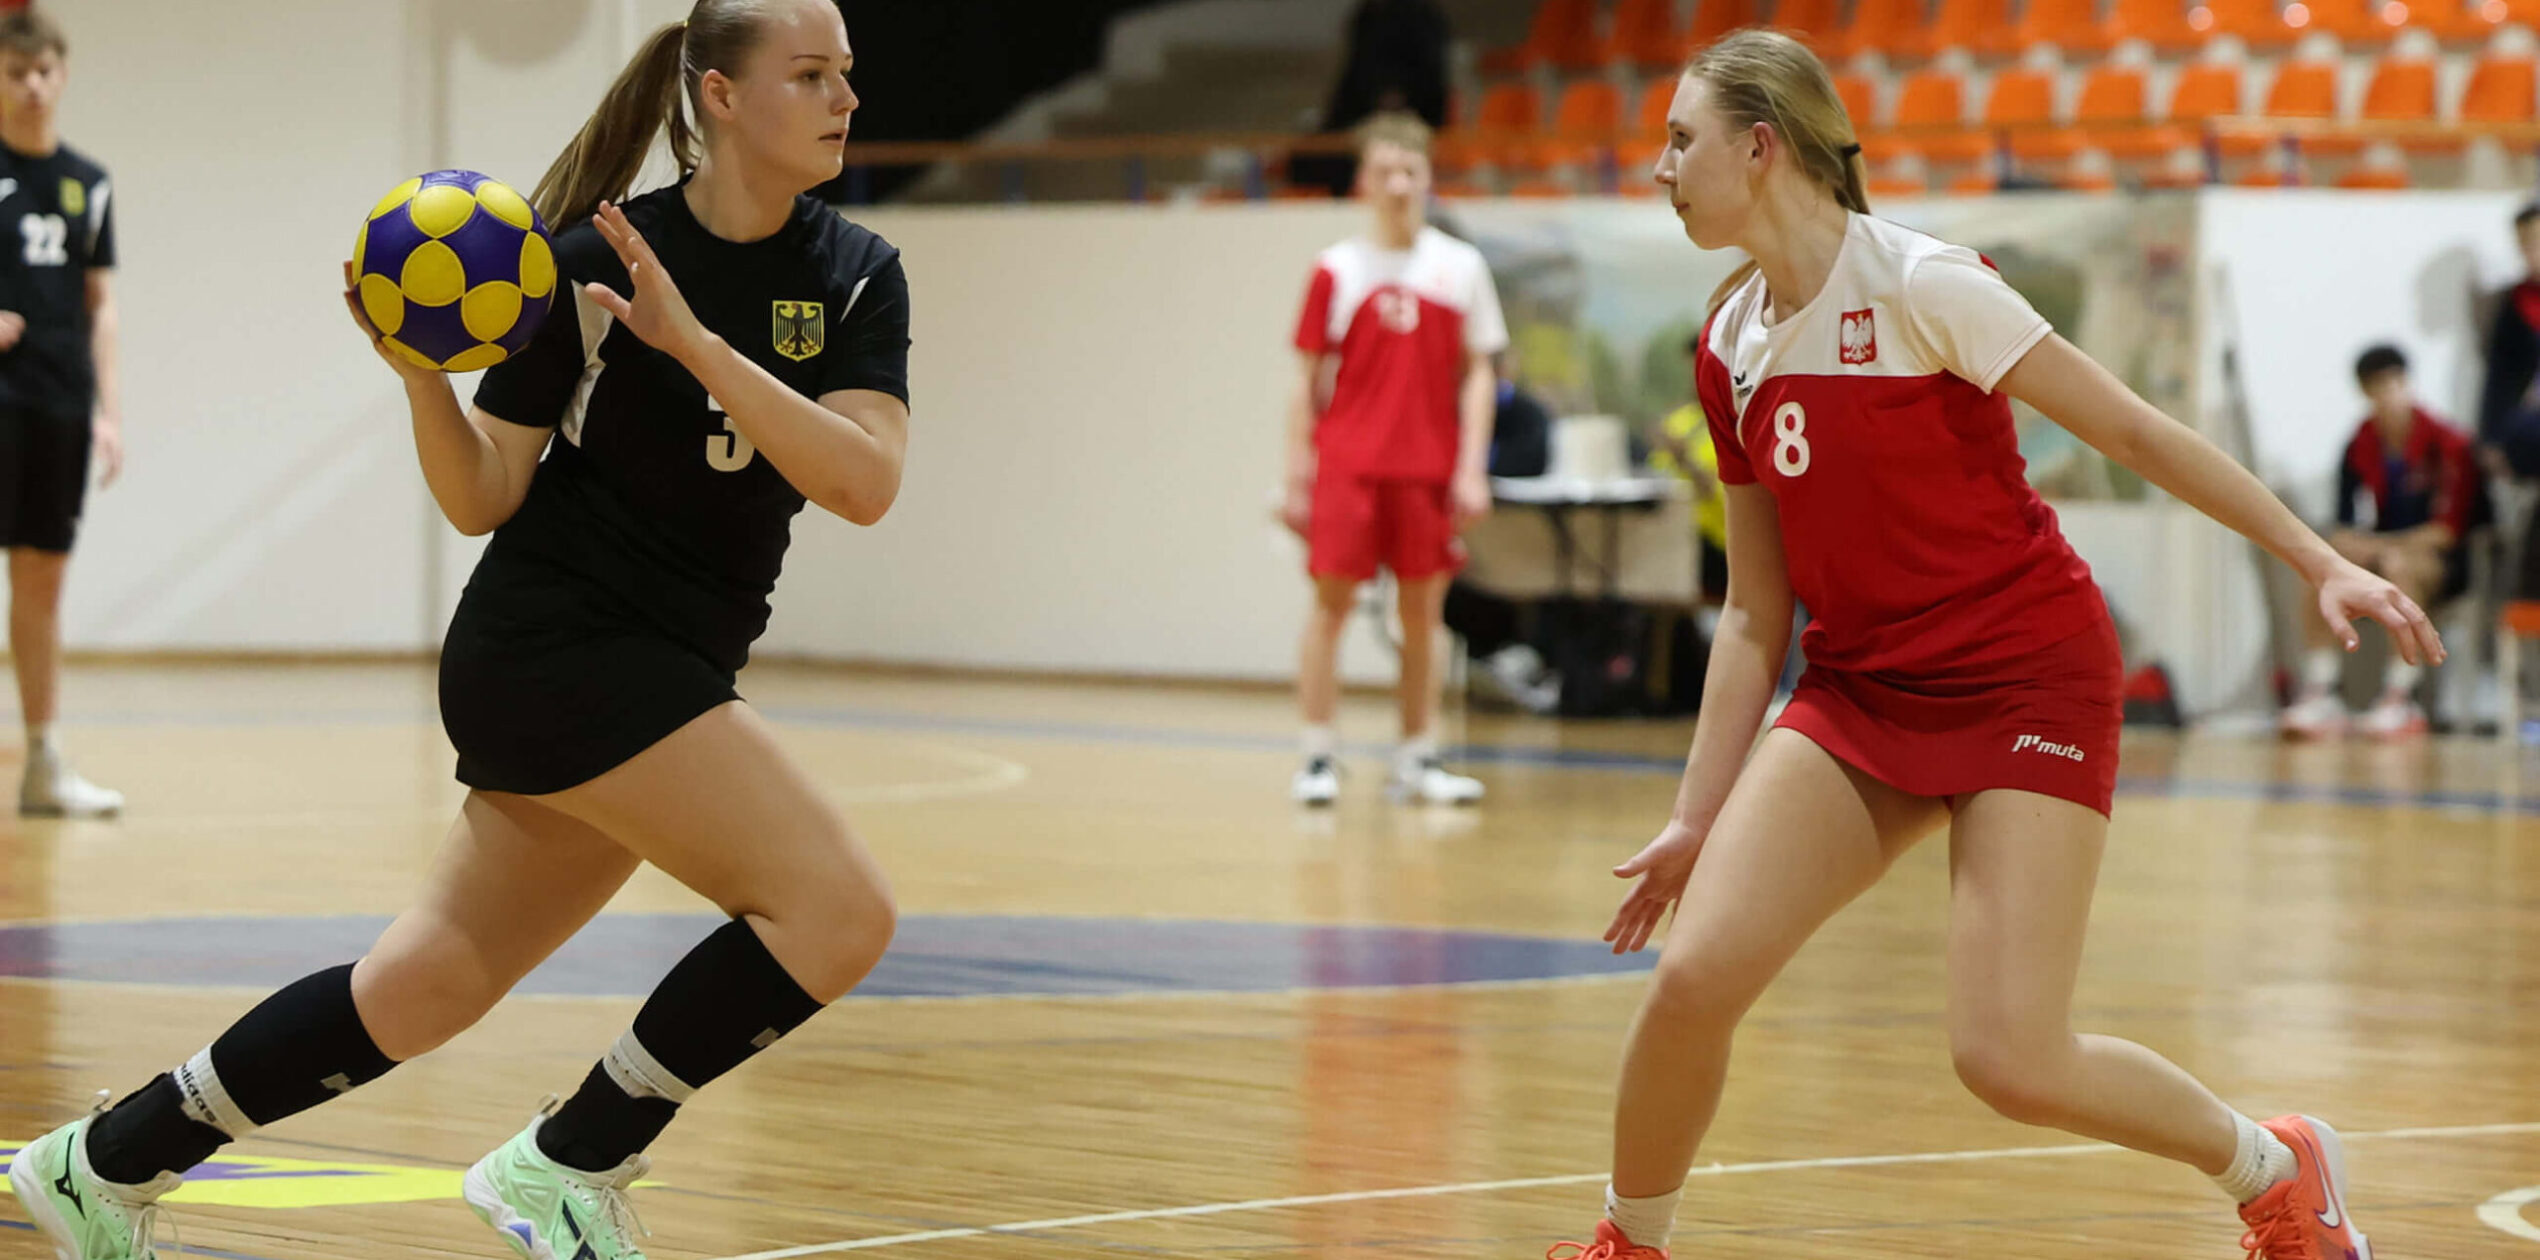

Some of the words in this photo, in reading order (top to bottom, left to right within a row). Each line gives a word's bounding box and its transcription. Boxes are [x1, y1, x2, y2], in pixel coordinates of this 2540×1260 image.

[20, 213, 68, 266] 22
[1773, 401, 1811, 478] 8
[2036, 741, 2085, 762] muta
